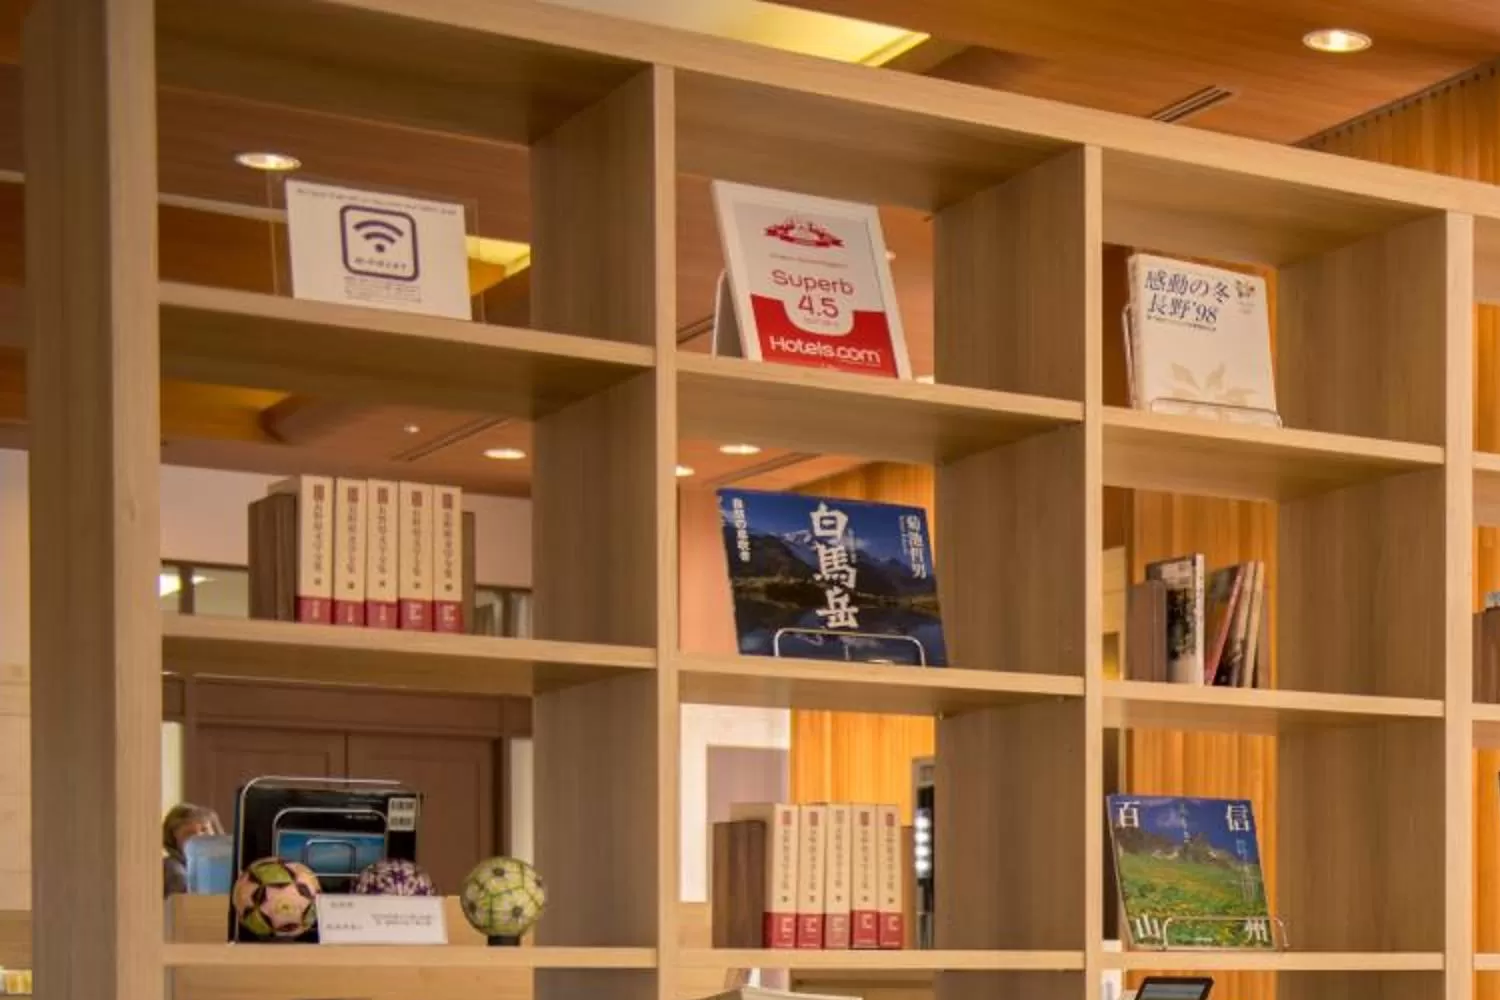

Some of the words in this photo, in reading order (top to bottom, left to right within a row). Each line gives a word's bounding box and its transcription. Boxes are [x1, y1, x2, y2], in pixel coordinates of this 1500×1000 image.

[772, 269, 854, 296] Superb
[798, 296, 839, 319] 4.5
[769, 335, 880, 363] Hotels.com
[809, 501, 859, 628] 白馬岳
[1116, 801, 1140, 828] 百
[1136, 914, 1161, 939] 山
[1225, 803, 1250, 832] 信
[1245, 919, 1268, 942] 州
